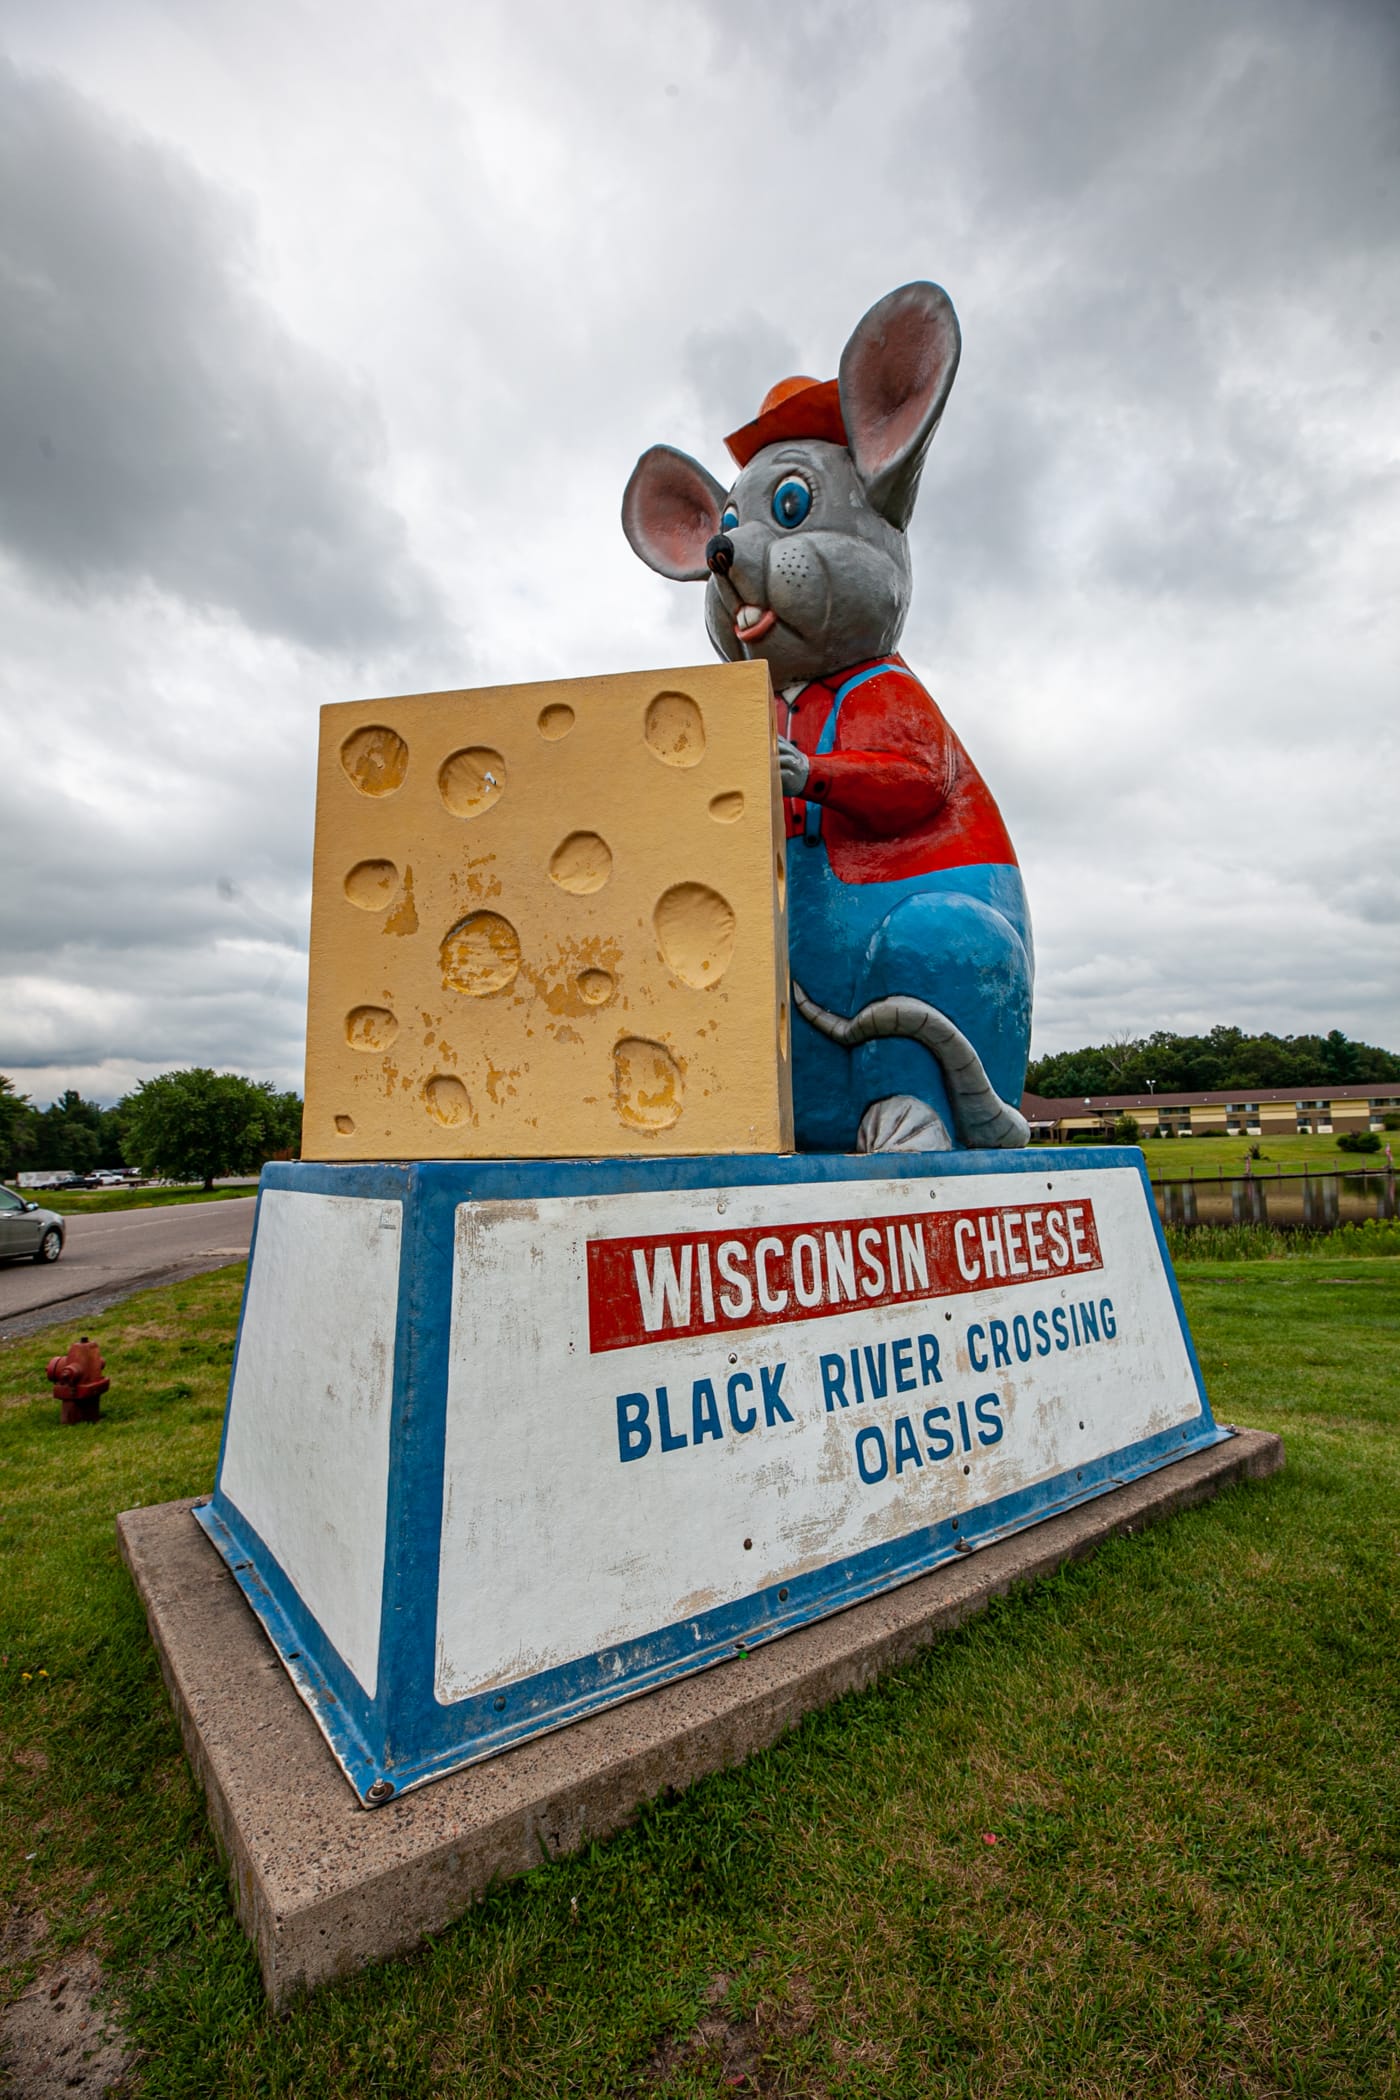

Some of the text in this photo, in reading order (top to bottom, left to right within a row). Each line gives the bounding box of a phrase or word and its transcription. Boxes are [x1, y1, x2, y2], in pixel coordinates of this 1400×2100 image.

[632, 1207, 1091, 1332] WISCONSIN CHEESE
[616, 1298, 1117, 1463] BLACK RIVER CROSSING
[855, 1392, 1004, 1485] OASIS
